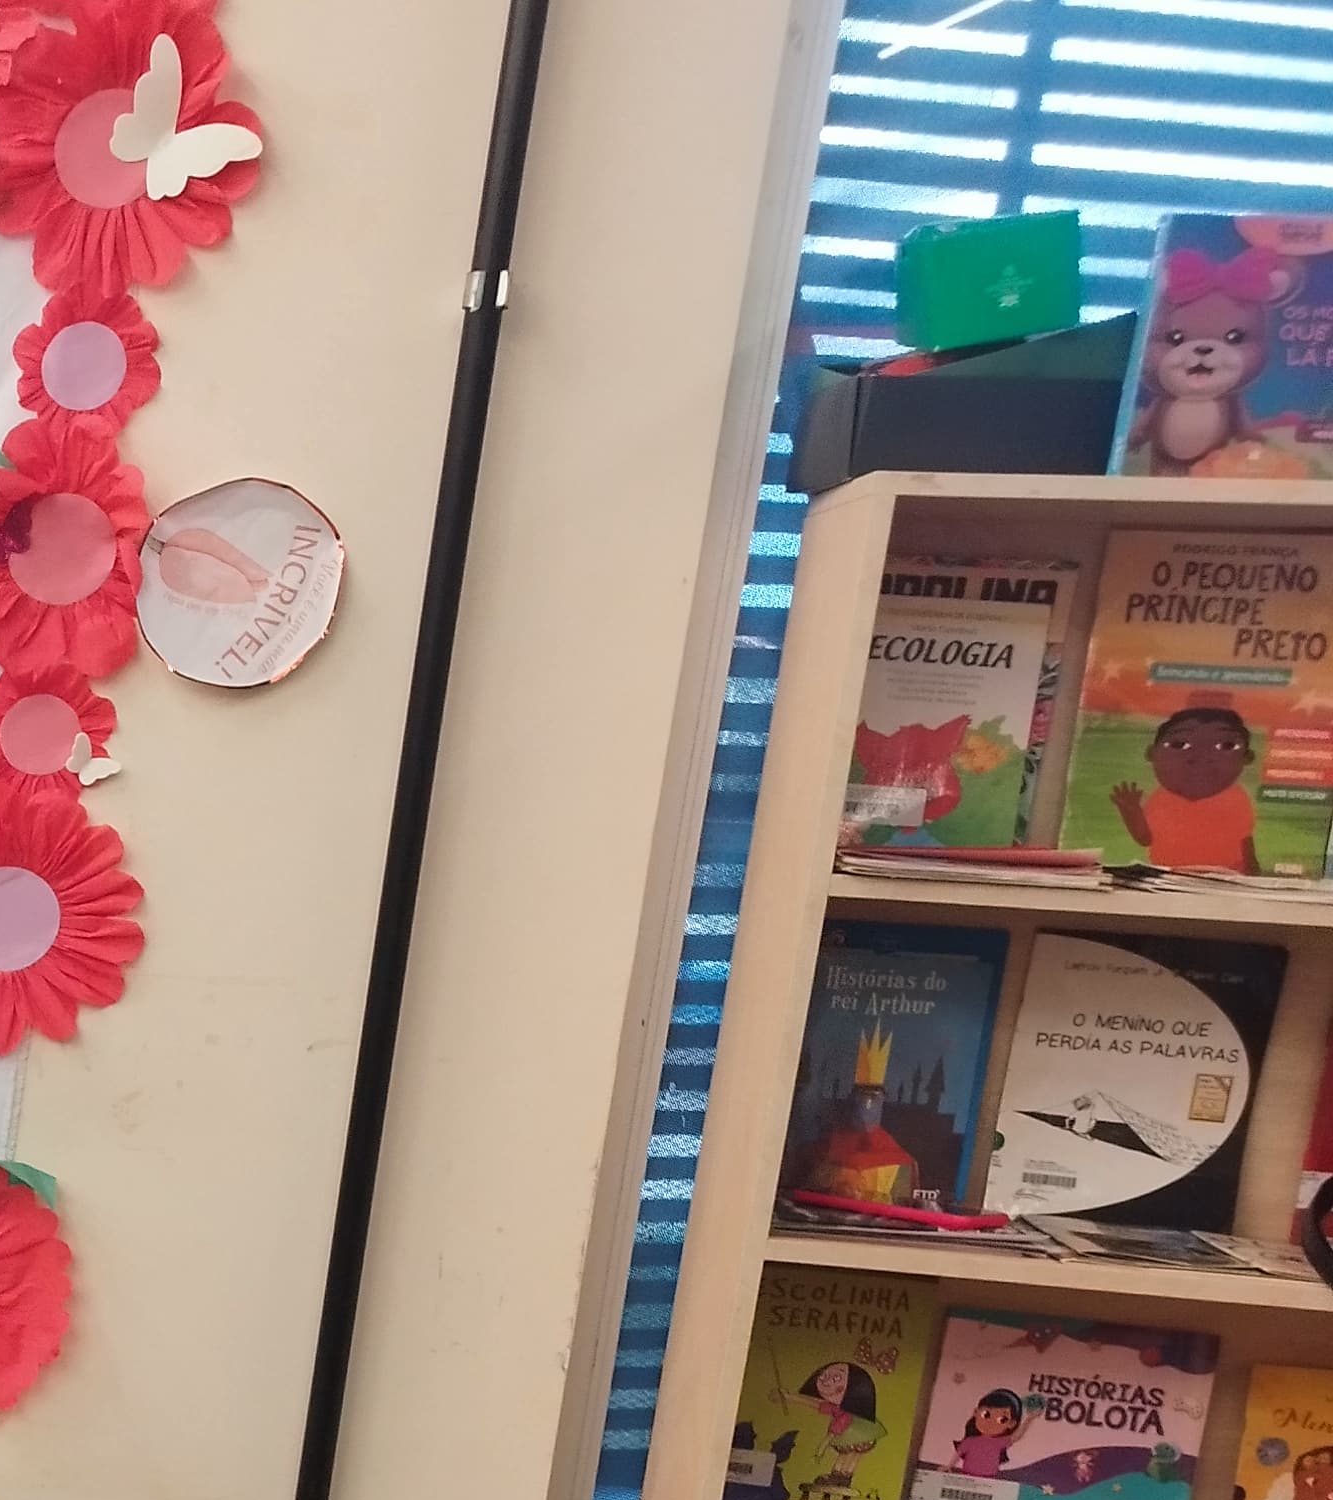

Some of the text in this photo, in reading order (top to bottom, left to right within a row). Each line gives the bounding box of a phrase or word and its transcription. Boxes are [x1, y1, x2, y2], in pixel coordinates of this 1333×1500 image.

[1152, 561, 1318, 594] O PEQUENO
[214, 524, 322, 680] INCRÍVEL!
[1125, 587, 1266, 626] PRÍNCIPE
[869, 634, 1014, 669] ECOLOGIA
[1234, 628, 1327, 661] PRETO
[826, 965, 949, 992] Histórias do
[831, 991, 936, 1016] rei Arthur
[1073, 1013, 1086, 1028] O
[1172, 1021, 1212, 1037] QUE
[1108, 1040, 1132, 1054] AS
[1139, 1040, 1239, 1064] PALAVRAS
[768, 1306, 903, 1339] SERAFINA
[1028, 1373, 1165, 1407] HISTÓRIAS
[1044, 1397, 1165, 1436] BOLOTA
